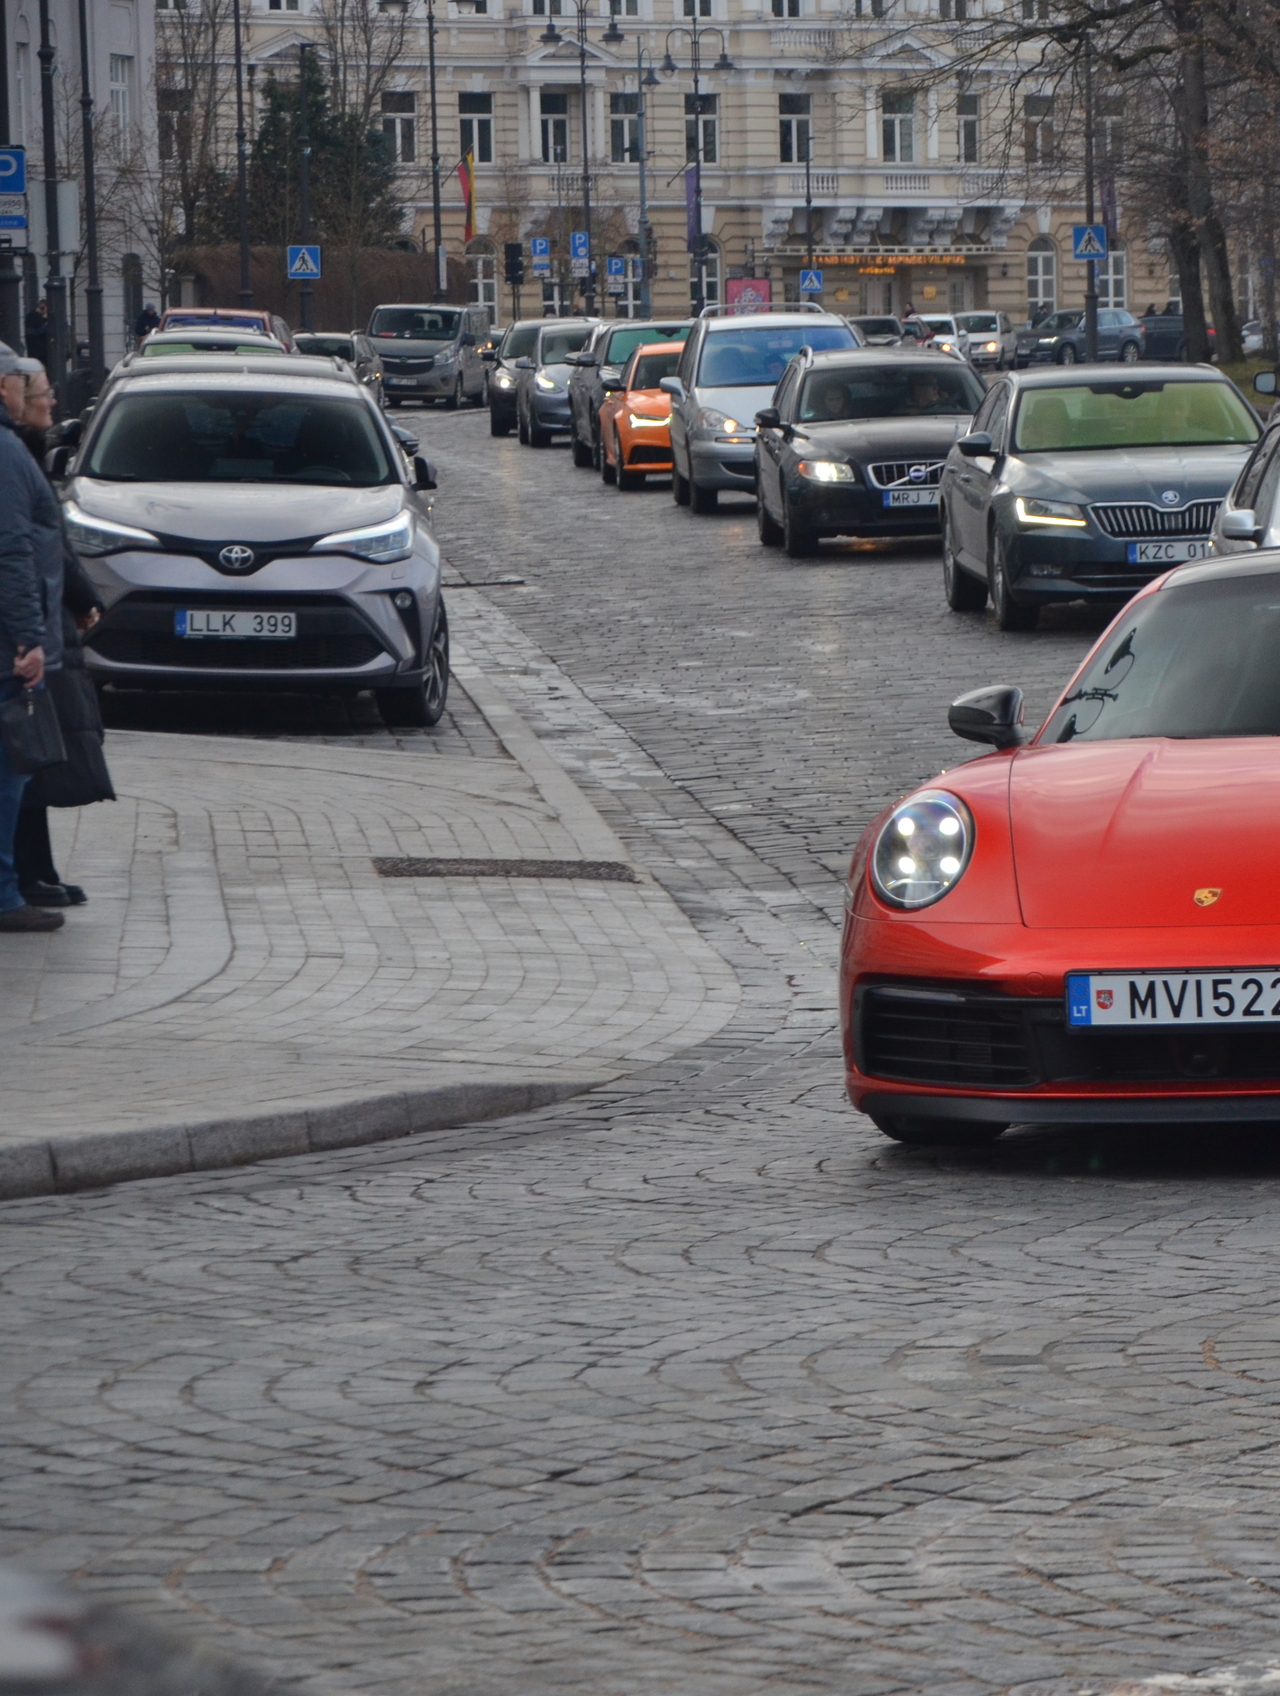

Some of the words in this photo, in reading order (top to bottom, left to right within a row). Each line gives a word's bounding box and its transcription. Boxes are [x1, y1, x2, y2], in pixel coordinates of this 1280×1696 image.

[536, 240, 546, 254] P
[576, 233, 585, 247] P
[612, 260, 621, 273] P
[892, 492, 920, 505] MRJ
[1139, 544, 1175, 560] KZC
[189, 613, 236, 633] LLK
[253, 614, 292, 634] 399
[1073, 1005, 1088, 1017] LT
